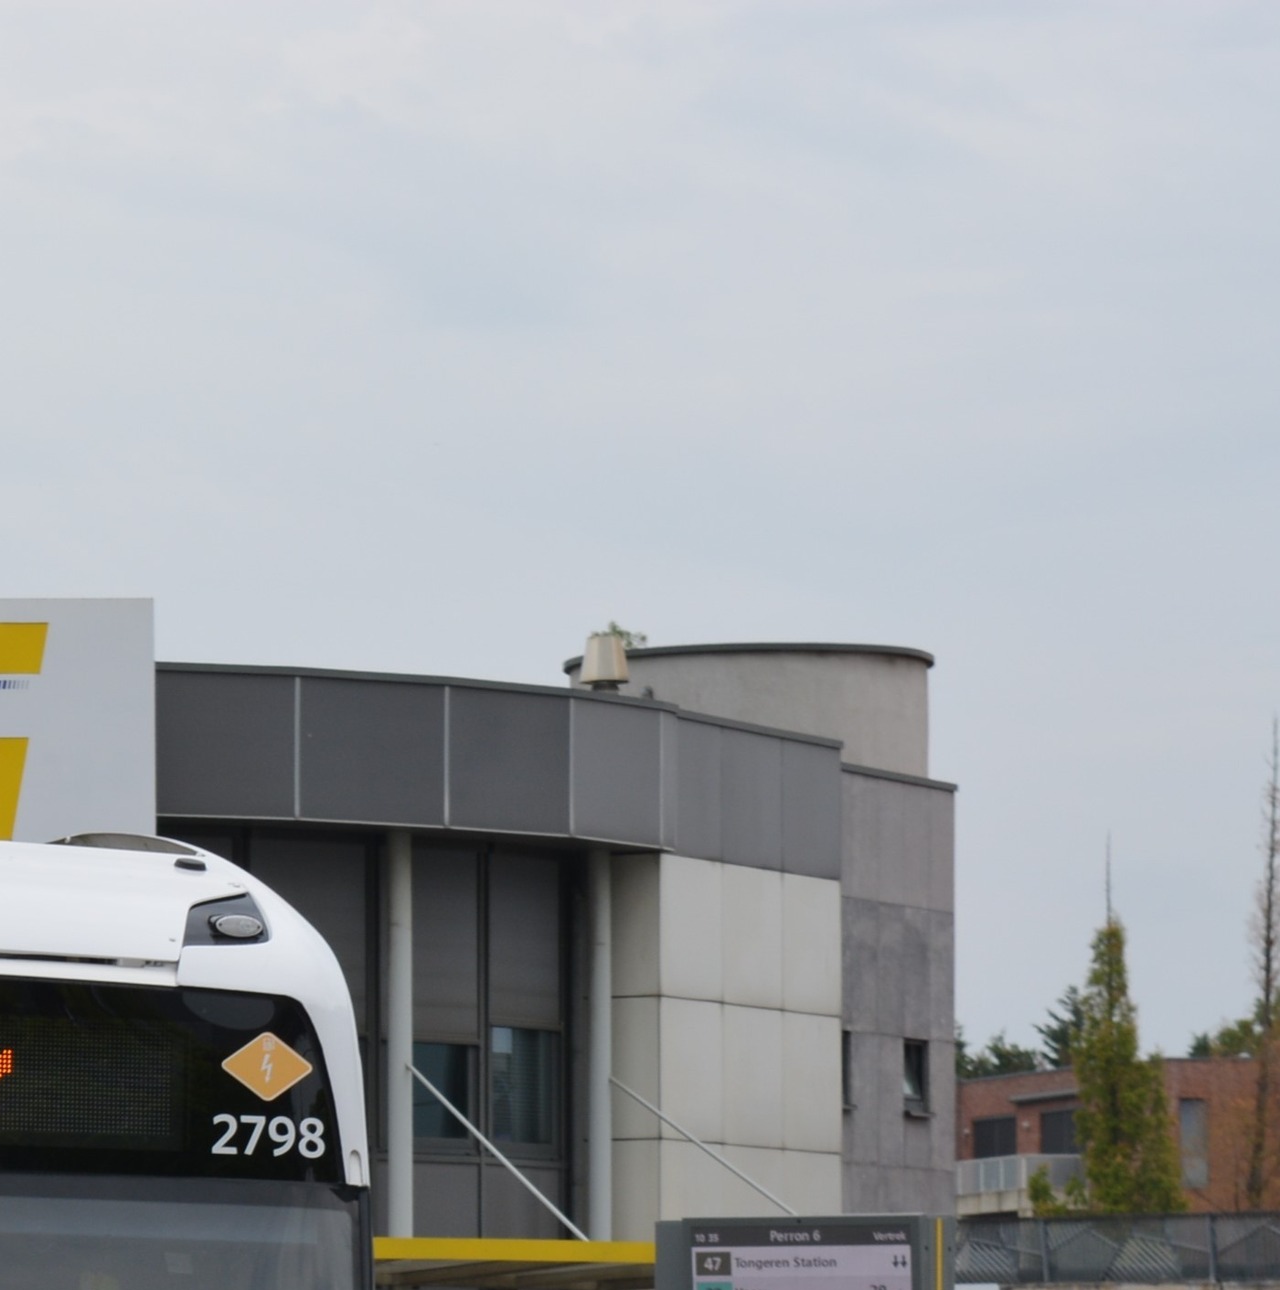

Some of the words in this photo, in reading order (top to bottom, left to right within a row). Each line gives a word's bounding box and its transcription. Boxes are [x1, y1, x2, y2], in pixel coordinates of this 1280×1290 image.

[212, 1114, 325, 1159] 2798
[770, 1230, 810, 1242] Perron
[703, 1257, 722, 1271] 47
[735, 1257, 790, 1270] Tongeren
[793, 1256, 837, 1268] Station
